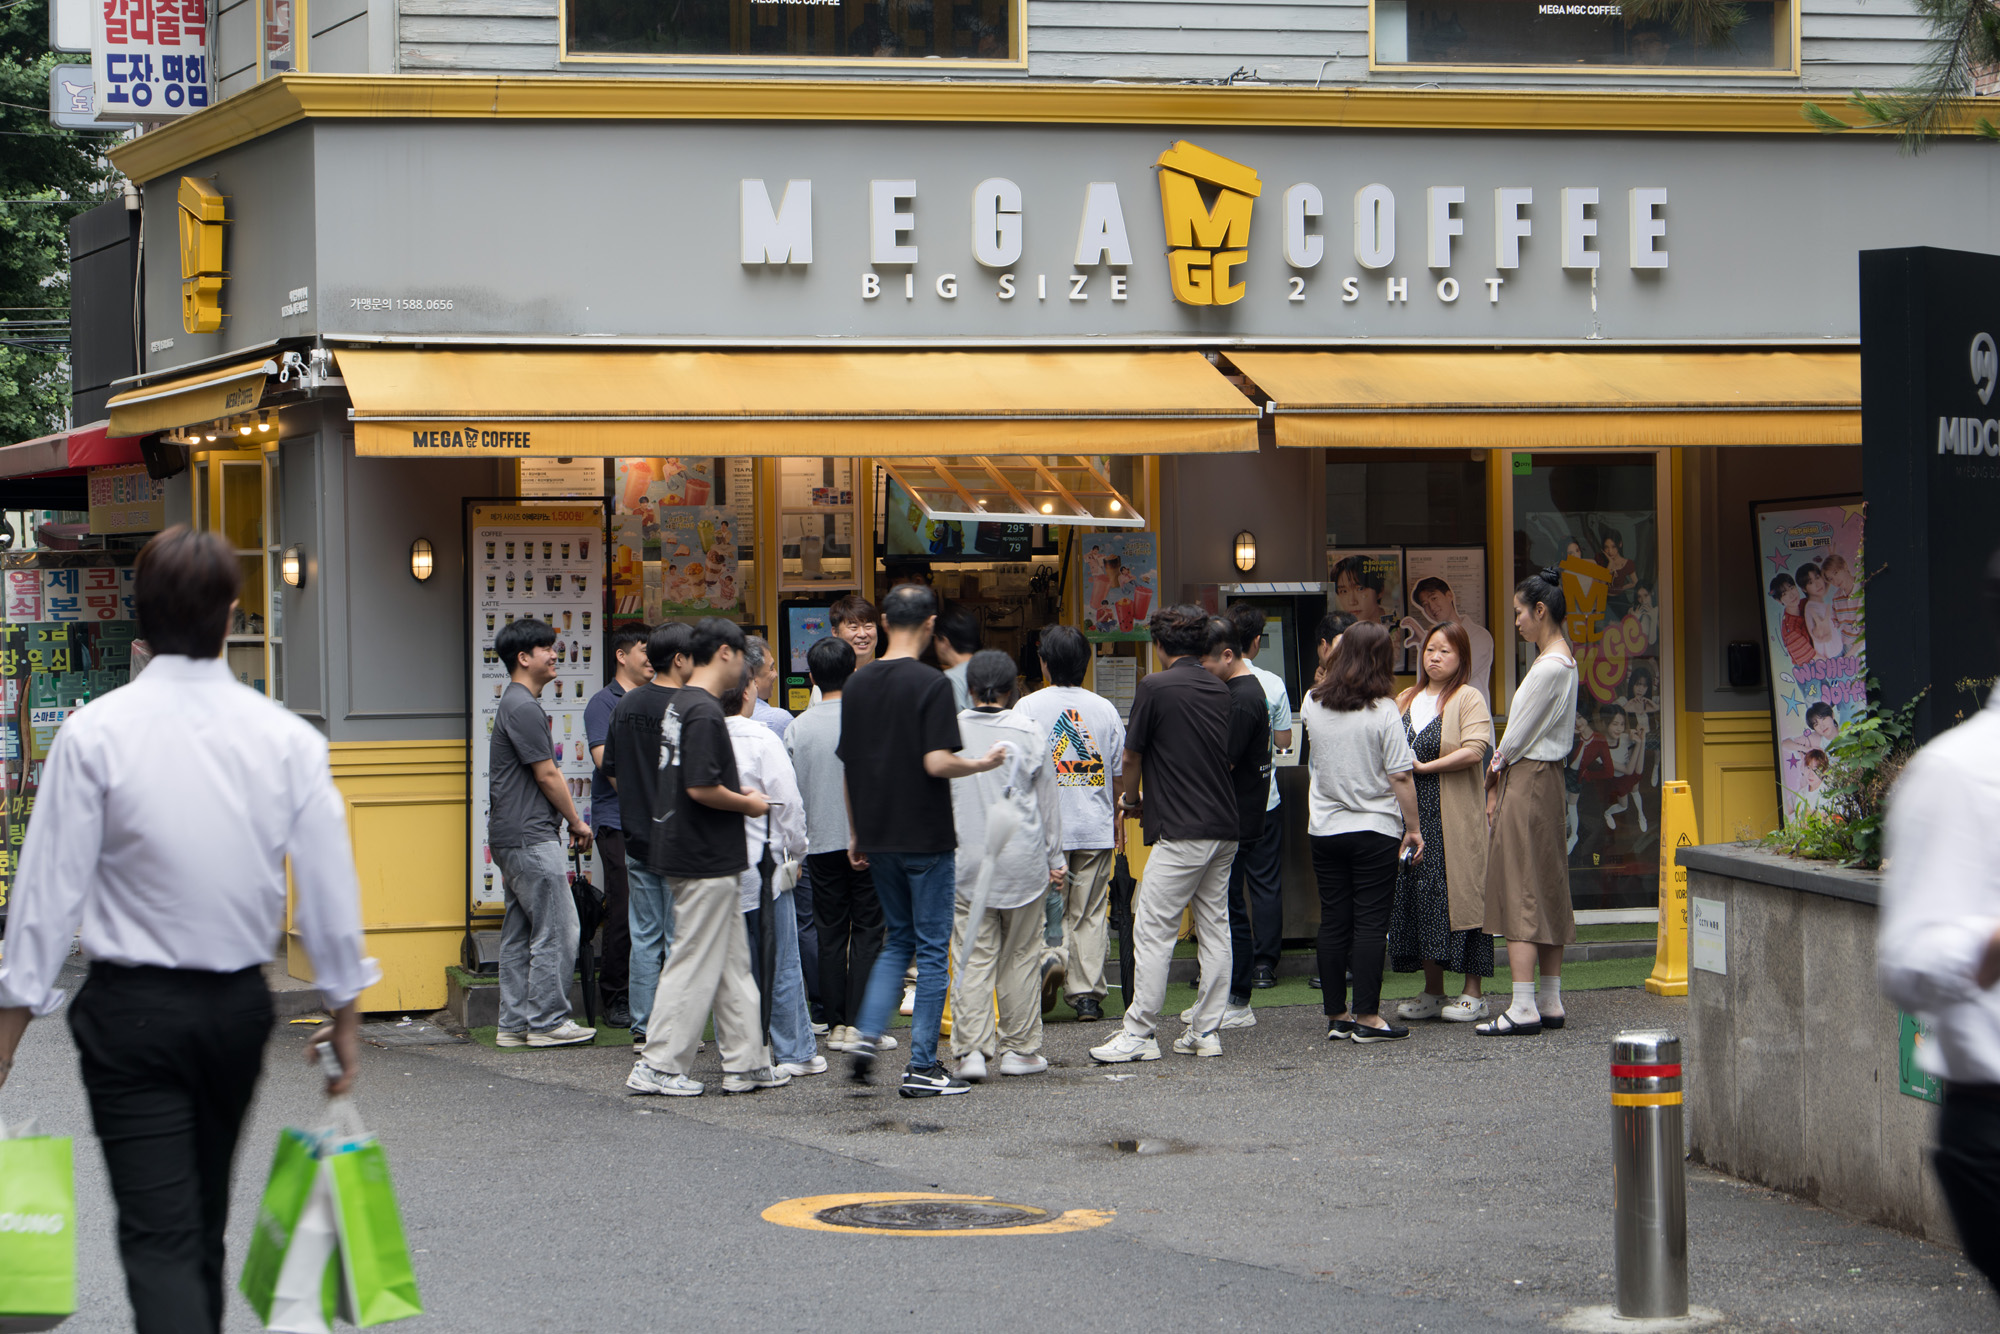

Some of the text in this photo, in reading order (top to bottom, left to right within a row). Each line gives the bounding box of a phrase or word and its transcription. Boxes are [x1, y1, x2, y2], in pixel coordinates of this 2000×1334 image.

[1539, 5, 1622, 15] MEGA MGC COFFEE
[72, 96, 94, 112] 도
[740, 178, 1668, 268] MEGA COFFEE
[862, 272, 1129, 301] BIG SIZE
[350, 298, 454, 311] 가맹문의 1588.0656
[413, 431, 531, 448] MEGA COFFEE
[1937, 416, 2000, 457] MIDC
[504, 513, 520, 521] 사이즈
[521, 513, 551, 521] 아메리카노
[1007, 524, 1025, 533] 295
[1009, 543, 1021, 552] 79
[1789, 537, 1831, 548] MEGA COFFEE
[9, 569, 42, 621] 열쇠
[46, 568, 81, 620] 제본
[84, 568, 119, 619] 코팅
[33, 710, 65, 723] 스마트폰
[1057, 773, 1094, 787] PALACE
[1698, 918, 1708, 928] CCTV
[0, 1212, 65, 1235] OUNG
